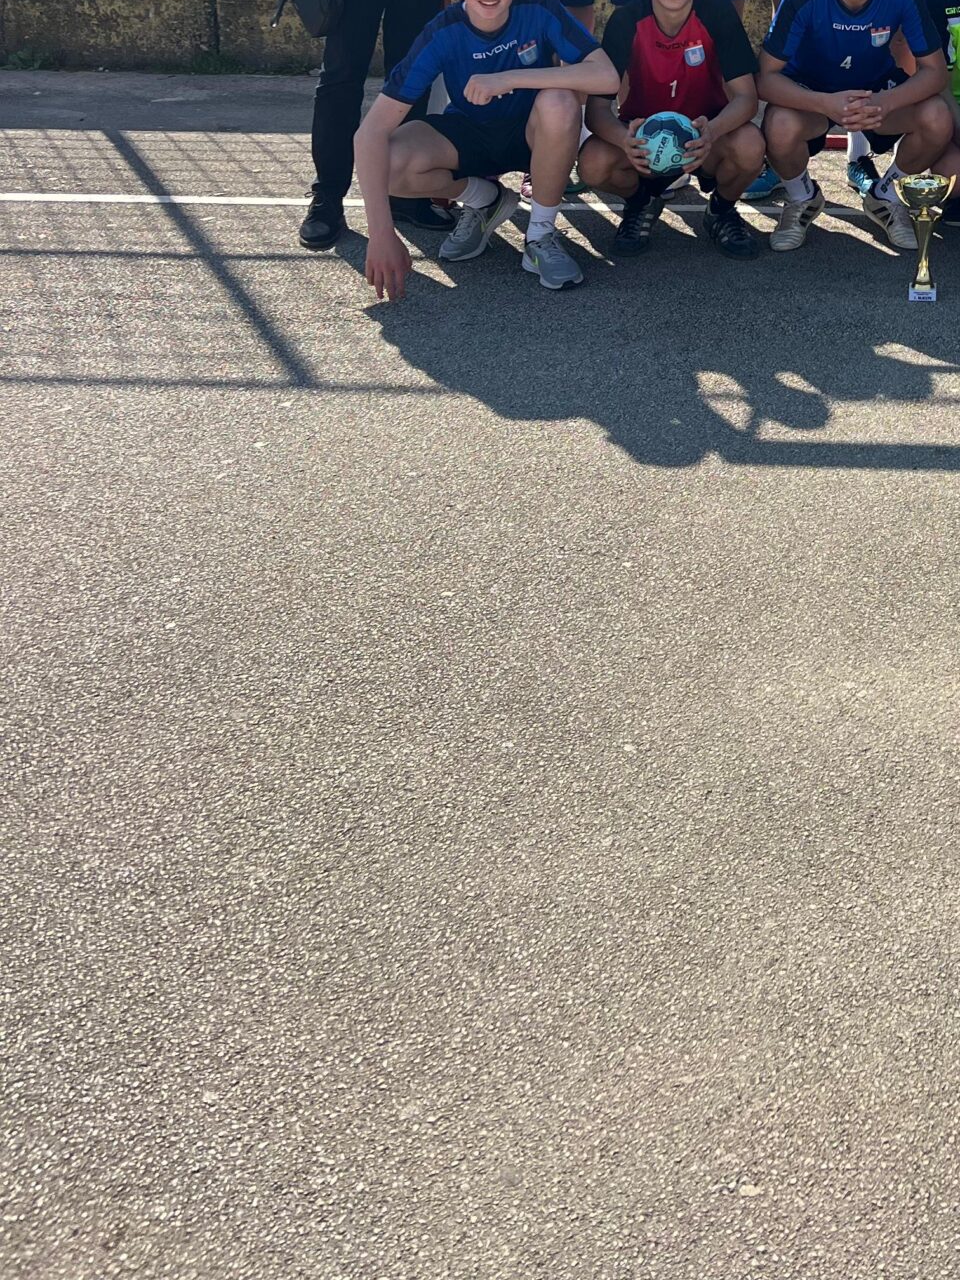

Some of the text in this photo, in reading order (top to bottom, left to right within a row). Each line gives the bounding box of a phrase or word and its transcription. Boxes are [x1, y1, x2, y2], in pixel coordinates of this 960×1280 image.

[472, 39, 518, 59] GIVOVA
[840, 55, 852, 70] 4
[669, 79, 678, 98] 1
